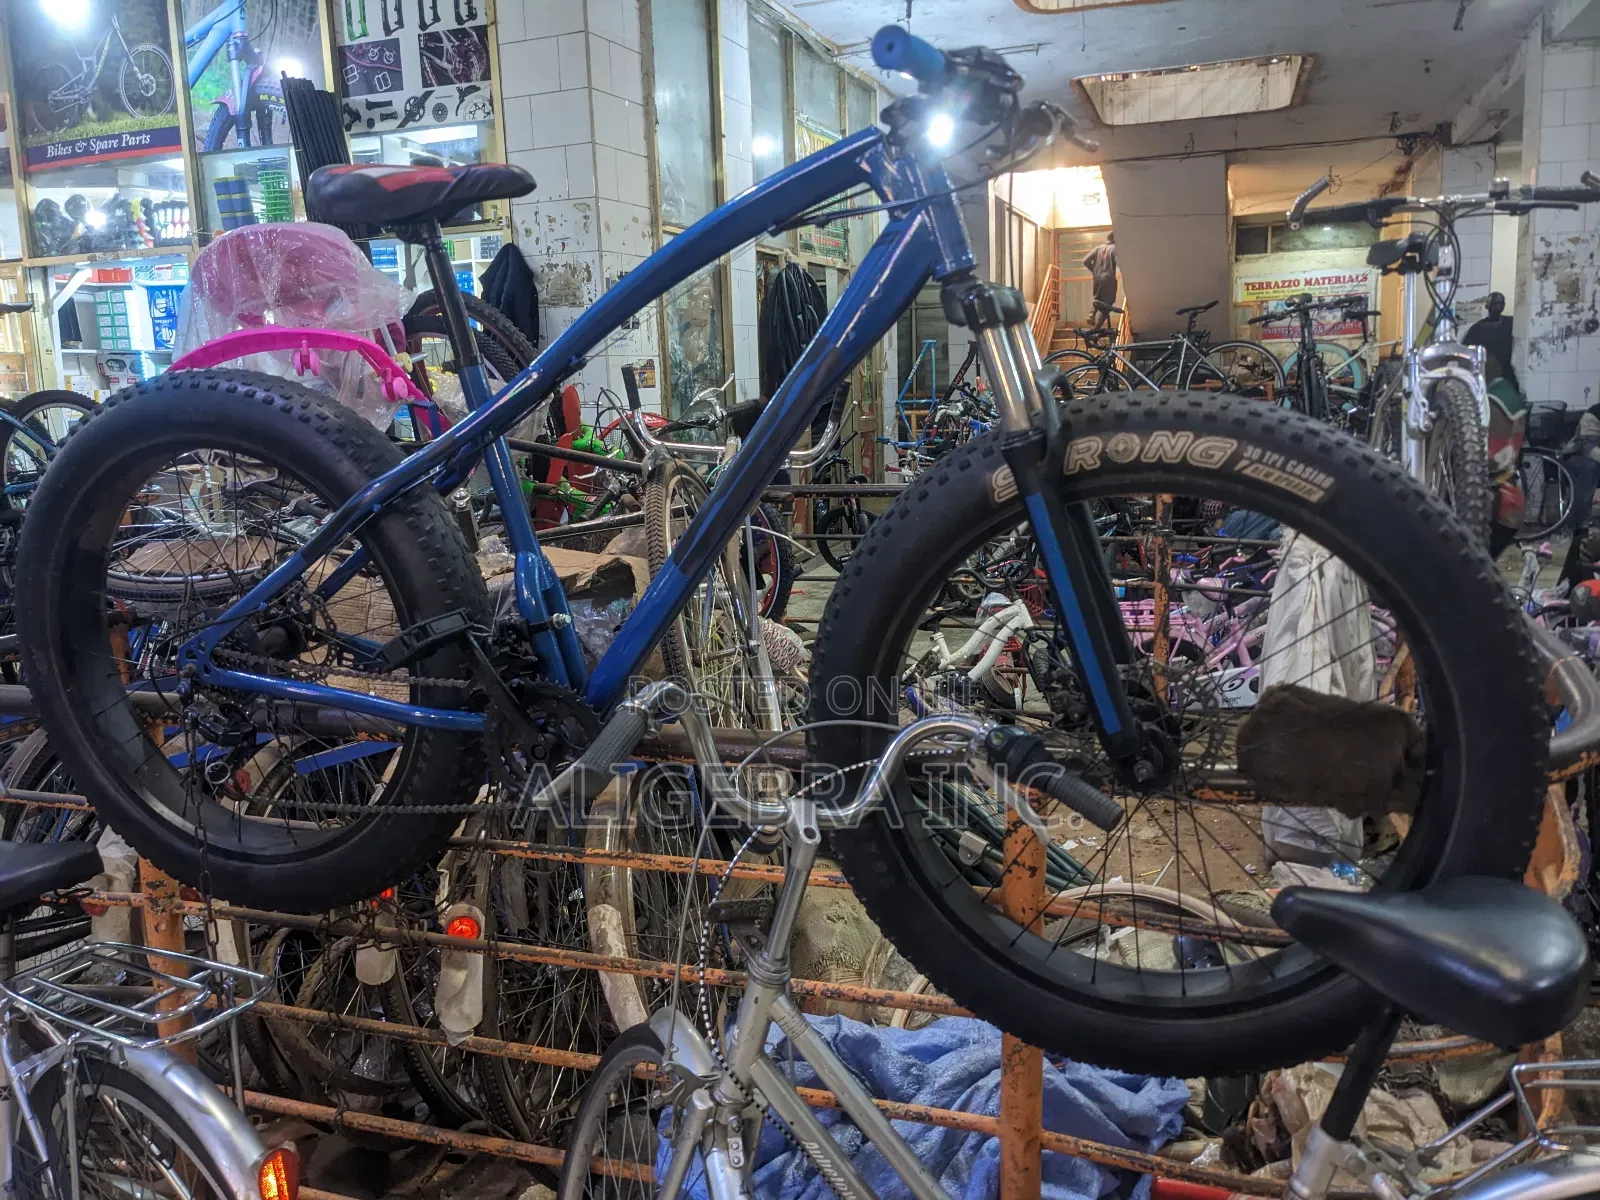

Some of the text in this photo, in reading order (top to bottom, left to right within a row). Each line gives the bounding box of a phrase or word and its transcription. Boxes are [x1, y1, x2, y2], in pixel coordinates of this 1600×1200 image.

[46, 133, 151, 158] Bikes & Spare Parts
[1243, 278, 1301, 292] TERRAZZO
[1303, 272, 1368, 287] MATERIALS
